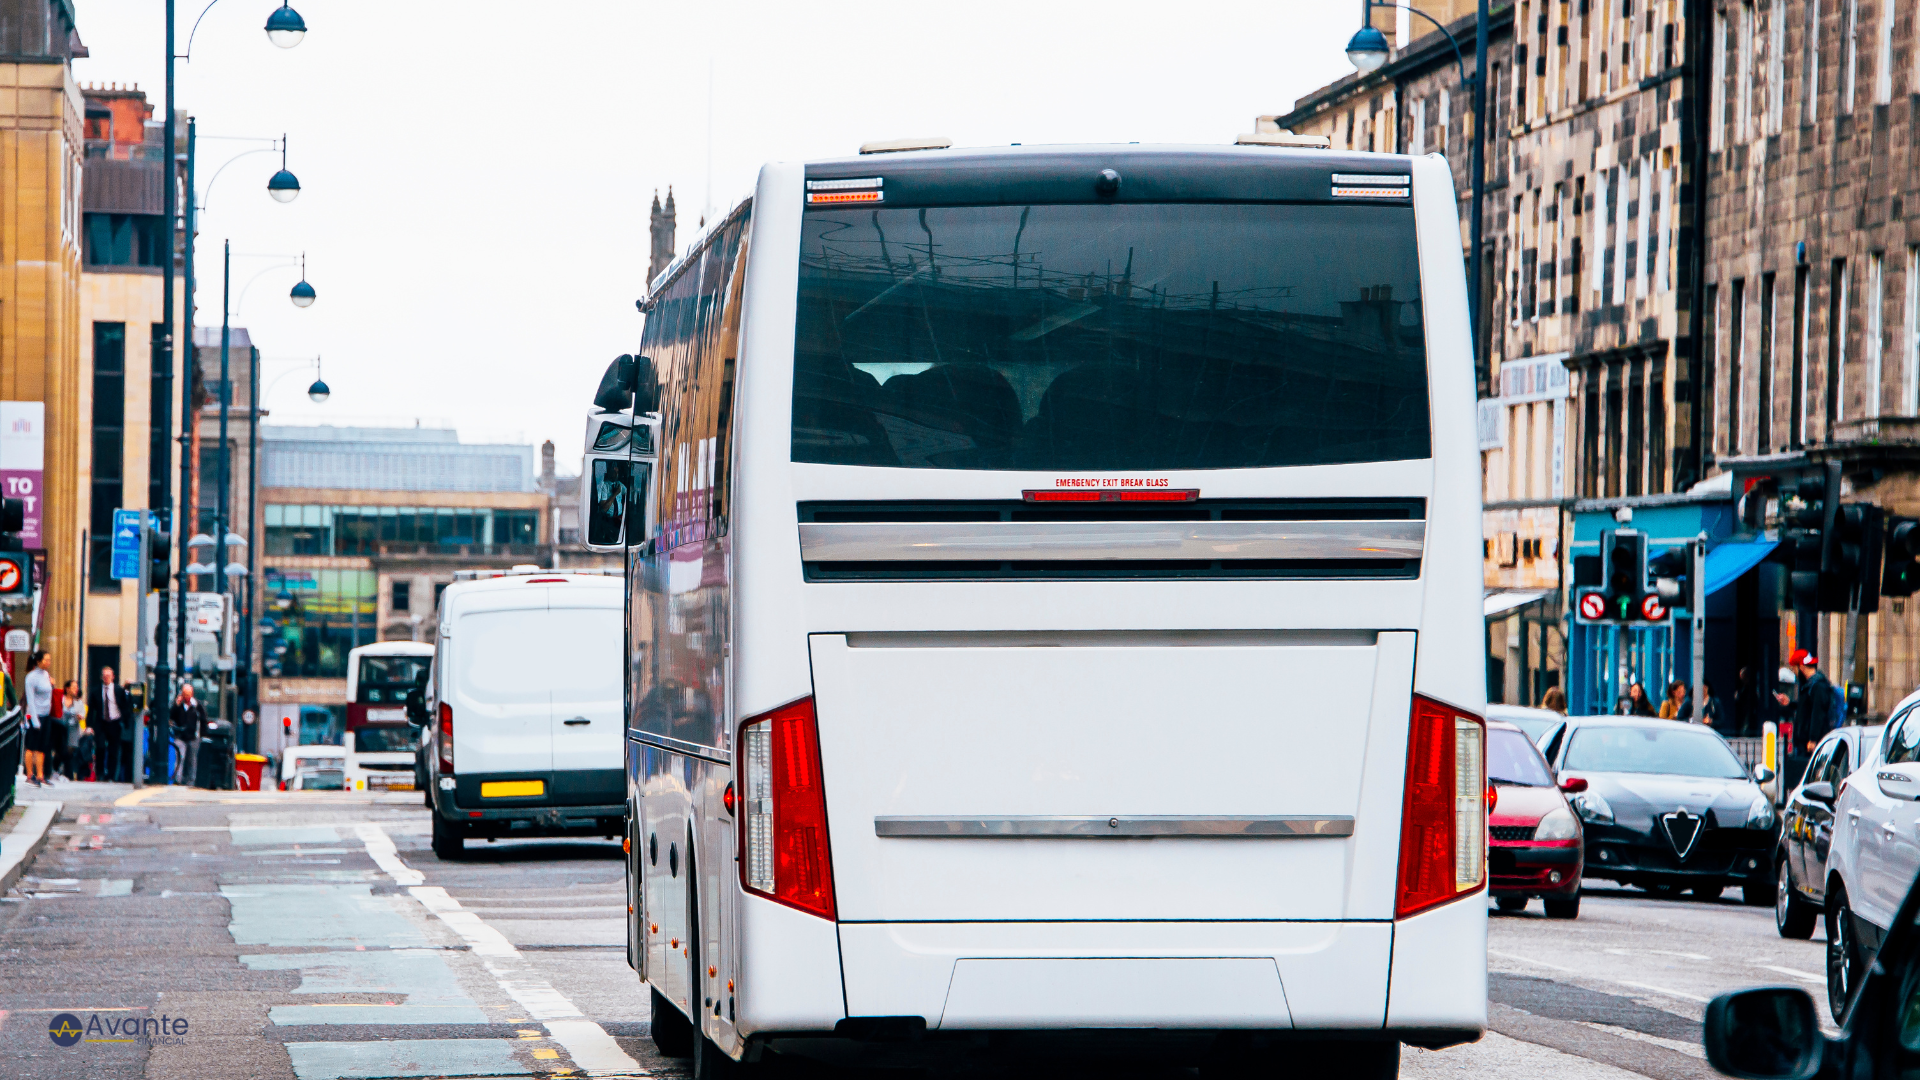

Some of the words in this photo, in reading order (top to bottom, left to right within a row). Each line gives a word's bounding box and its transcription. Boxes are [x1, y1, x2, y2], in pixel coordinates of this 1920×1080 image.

[7, 477, 33, 494] TO
[1056, 478, 1100, 487] EMERGENCY
[1102, 478, 1118, 487] EXIT
[1120, 478, 1143, 487] BREAK
[1146, 478, 1168, 487] GLASS
